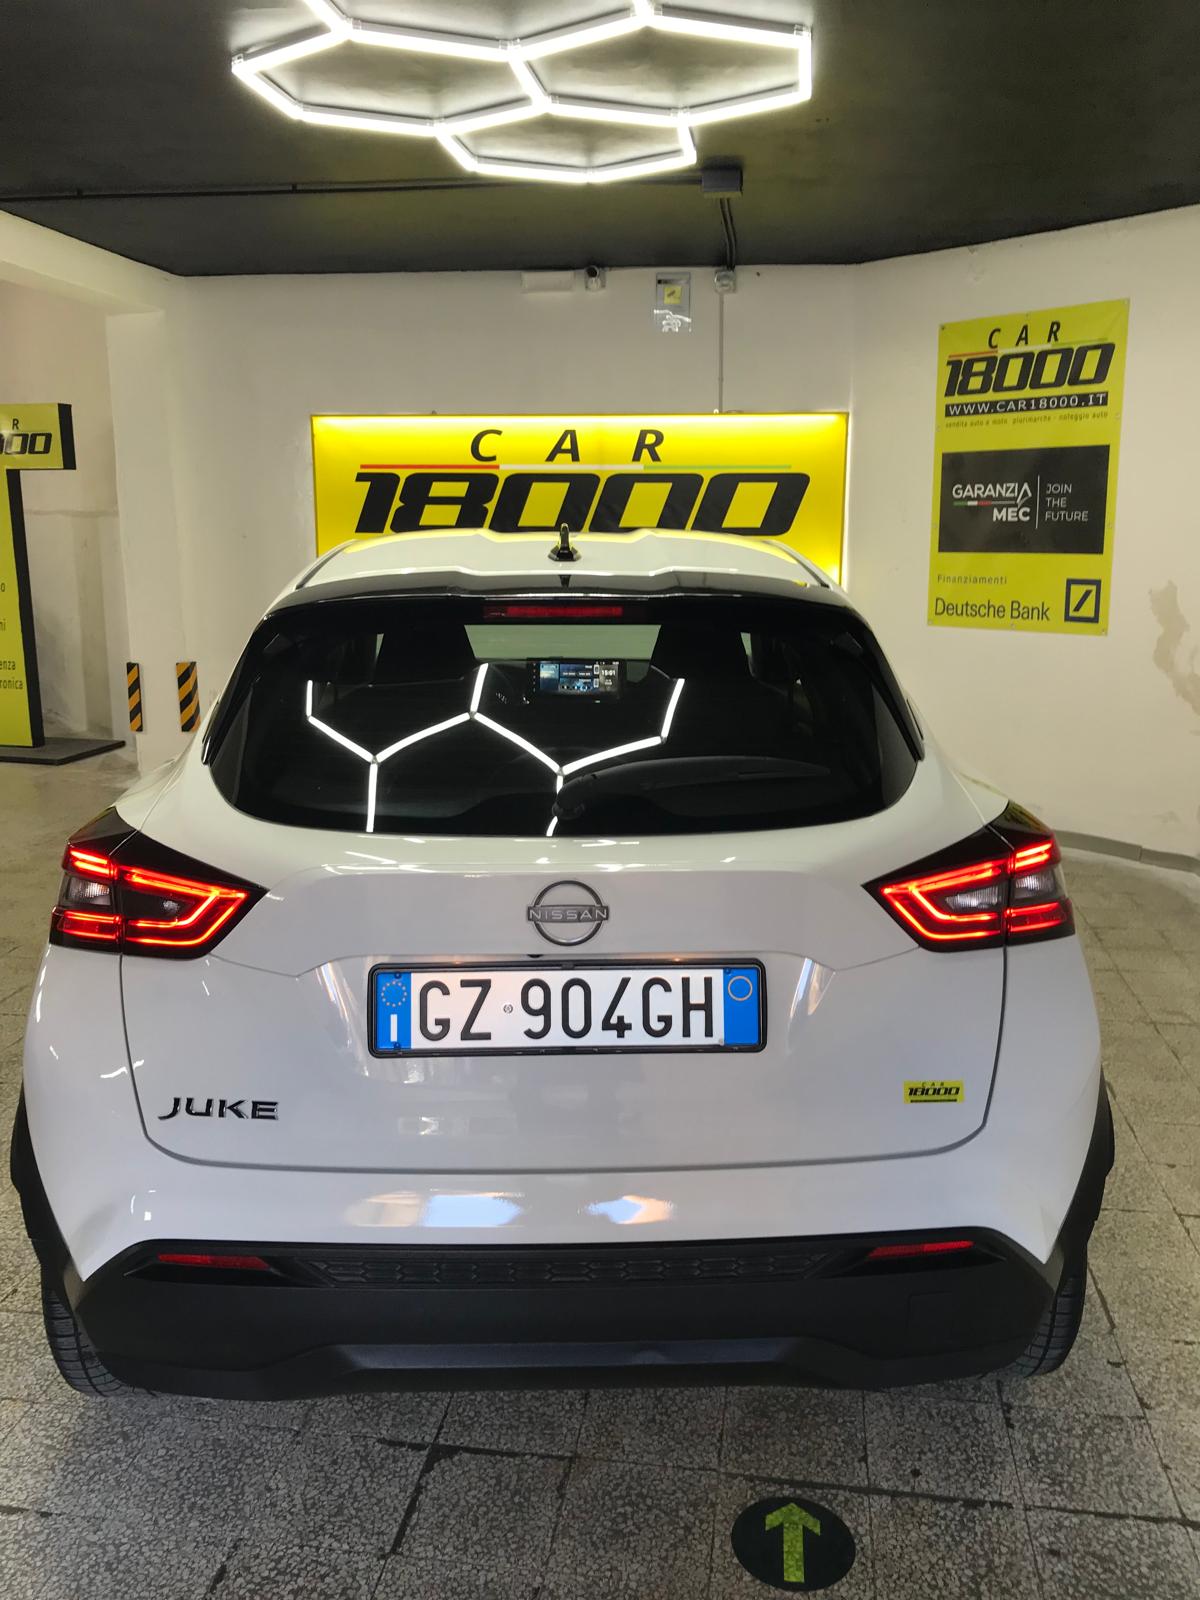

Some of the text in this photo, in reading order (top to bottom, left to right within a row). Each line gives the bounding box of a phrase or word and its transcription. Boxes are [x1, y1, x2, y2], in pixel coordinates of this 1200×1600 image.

[944, 343, 1116, 398] 18000
[949, 393, 1107, 416] WWW.CAR18000.IT
[0, 432, 53, 455] 00
[952, 482, 1073, 503] GARANZIA JOIN
[1046, 497, 1067, 508] THE
[354, 472, 811, 537] 18000
[992, 507, 1089, 522] MEC FUTURE
[937, 573, 1008, 585] Finanziamenti
[934, 597, 1050, 622] Deutsche Bank
[529, 908, 608, 920] NISSAN
[418, 975, 714, 1042] GZ 904GH
[908, 1087, 960, 1096] 18000
[158, 1097, 279, 1120] JUKE
